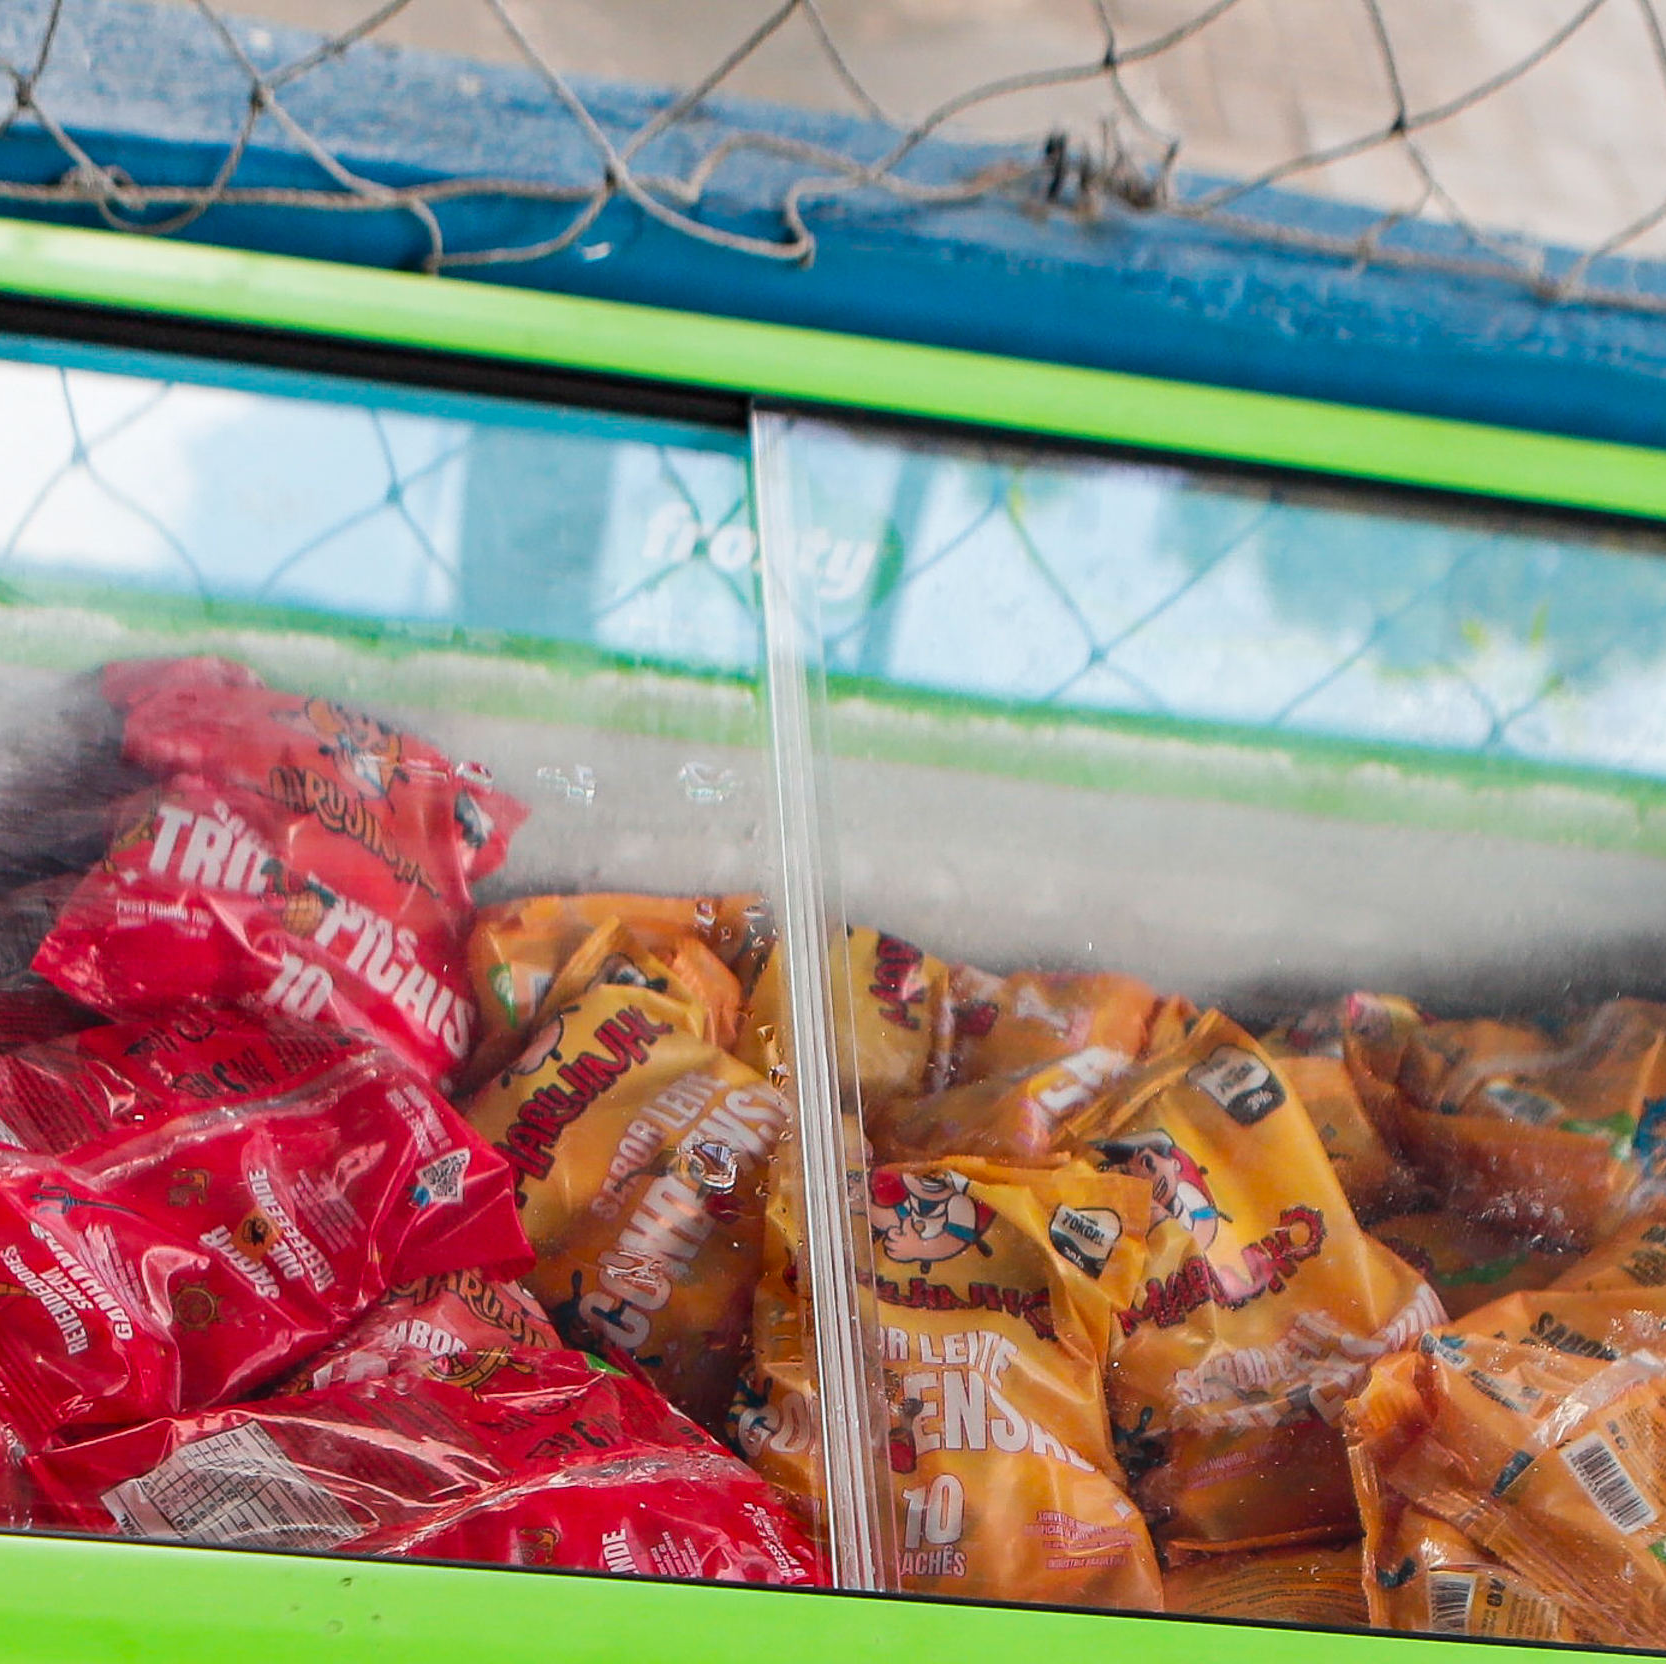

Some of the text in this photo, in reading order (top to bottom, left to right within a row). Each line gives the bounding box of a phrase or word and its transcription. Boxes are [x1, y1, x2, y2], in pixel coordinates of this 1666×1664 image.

[641, 512, 877, 602] froty
[264, 951, 333, 1023] 10
[658, 1069, 730, 1131] LEIT
[0, 1245, 90, 1356] REVENDEDORES
[39, 1265, 95, 1311] SAEM
[902, 1474, 965, 1550] 10
[899, 1545, 967, 1578] ACHÊS
